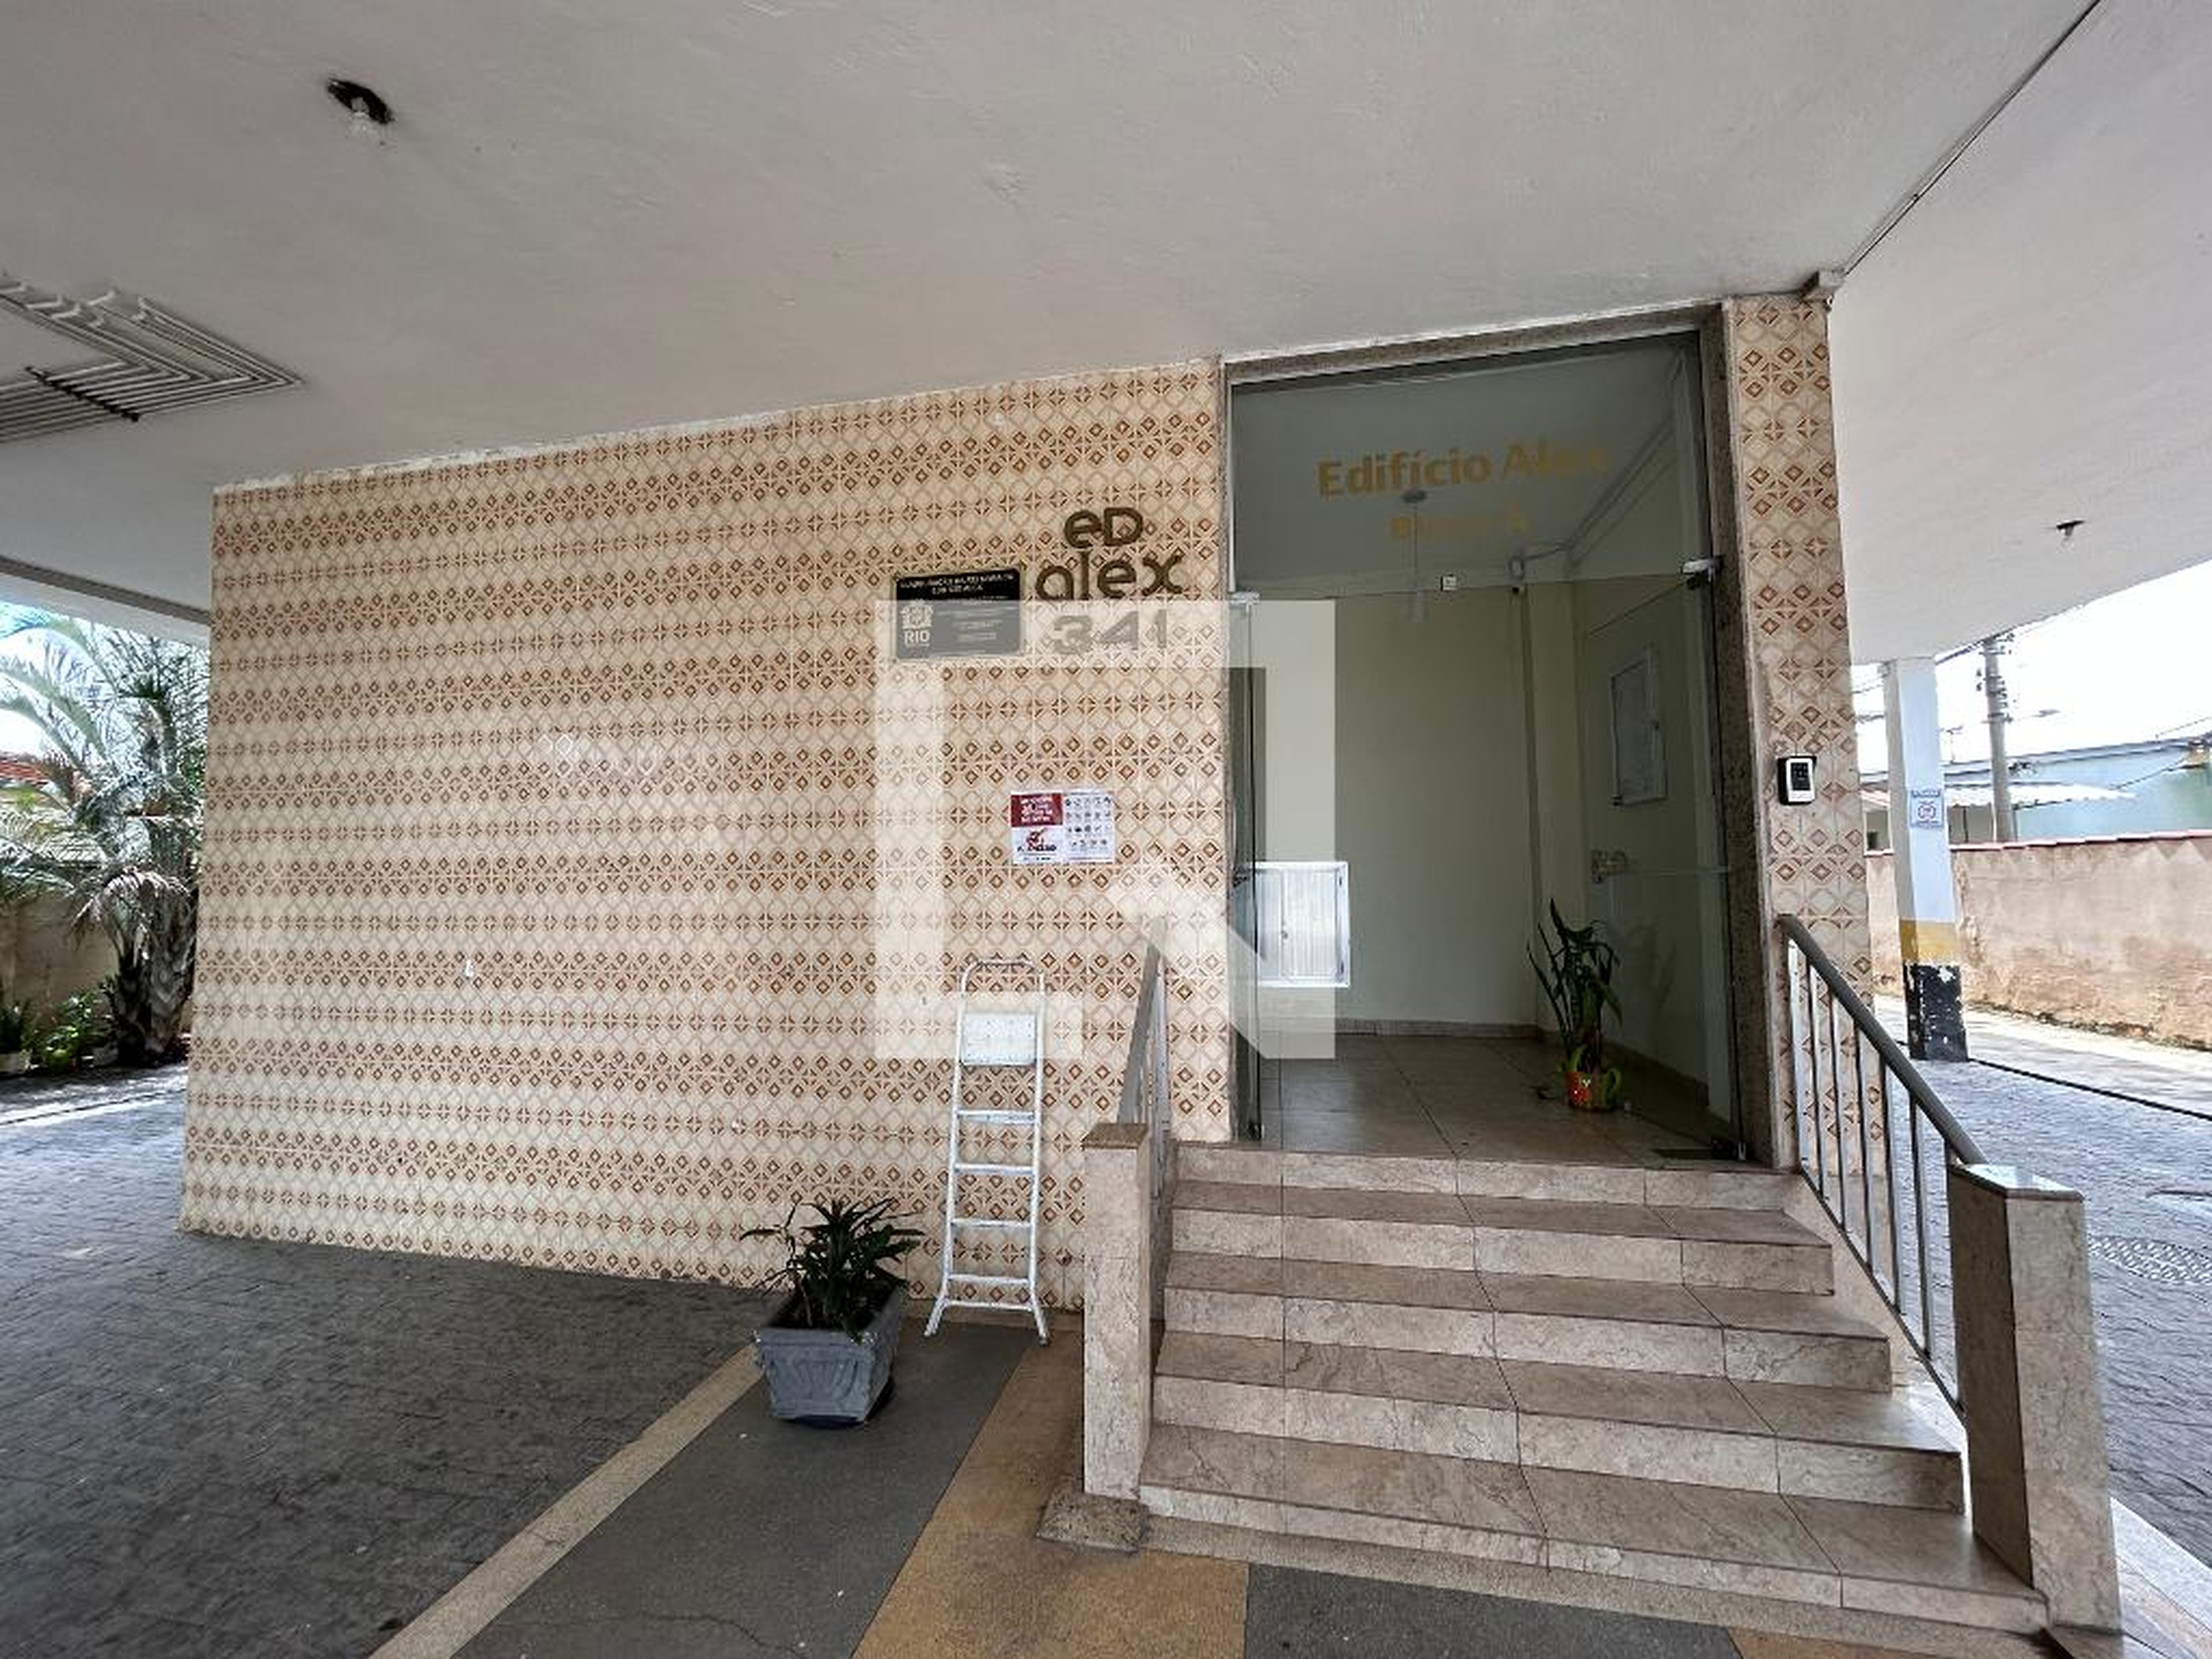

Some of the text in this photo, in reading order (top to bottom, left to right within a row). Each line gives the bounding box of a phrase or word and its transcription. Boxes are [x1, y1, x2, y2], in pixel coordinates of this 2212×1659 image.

[1316, 436, 1609, 499] Edifício Al
[1035, 551, 1184, 601] alex
[903, 630, 931, 644] RIO
[1053, 608, 1168, 655] 341
